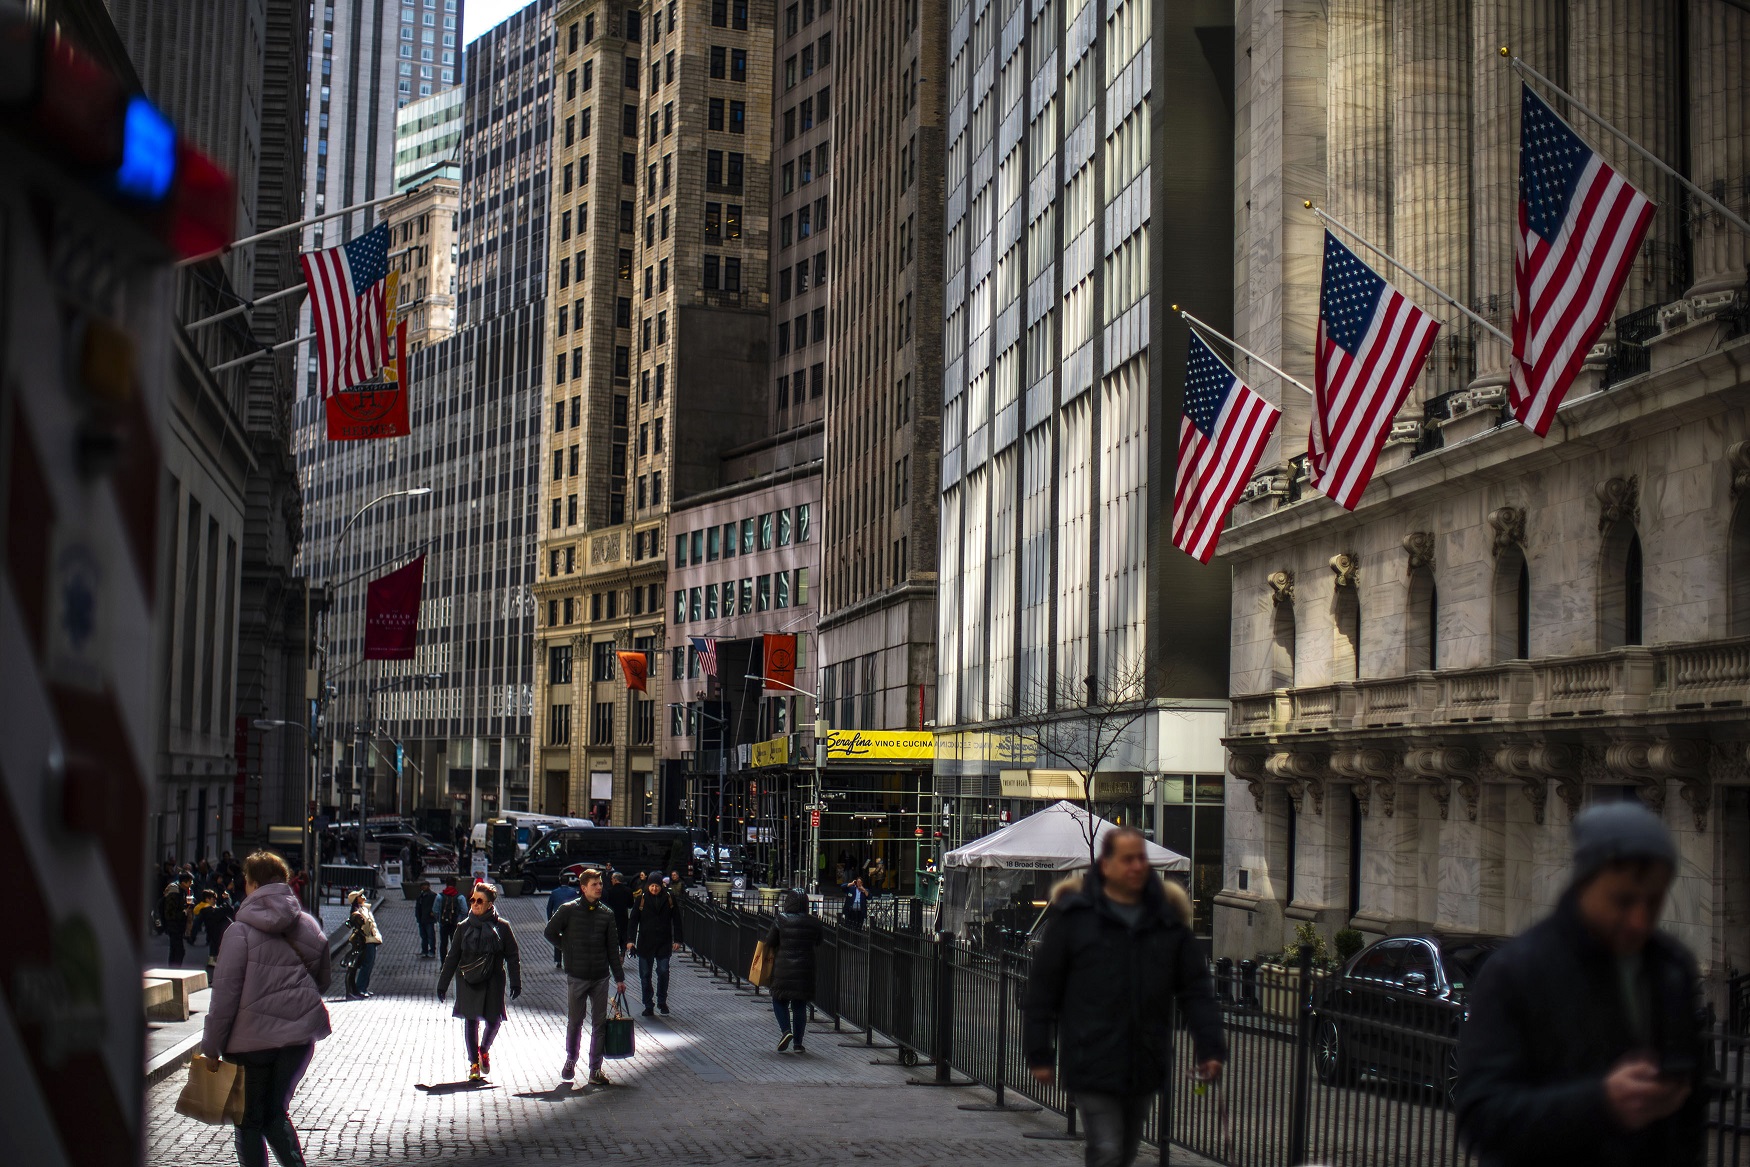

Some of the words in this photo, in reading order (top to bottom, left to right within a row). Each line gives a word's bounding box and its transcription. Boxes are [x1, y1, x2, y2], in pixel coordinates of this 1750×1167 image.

[827, 731, 873, 755] Serafina
[875, 740, 895, 748] VINO
[896, 740, 901, 748] E
[902, 740, 933, 748] CUCINA
[1034, 861, 1055, 869] Street
